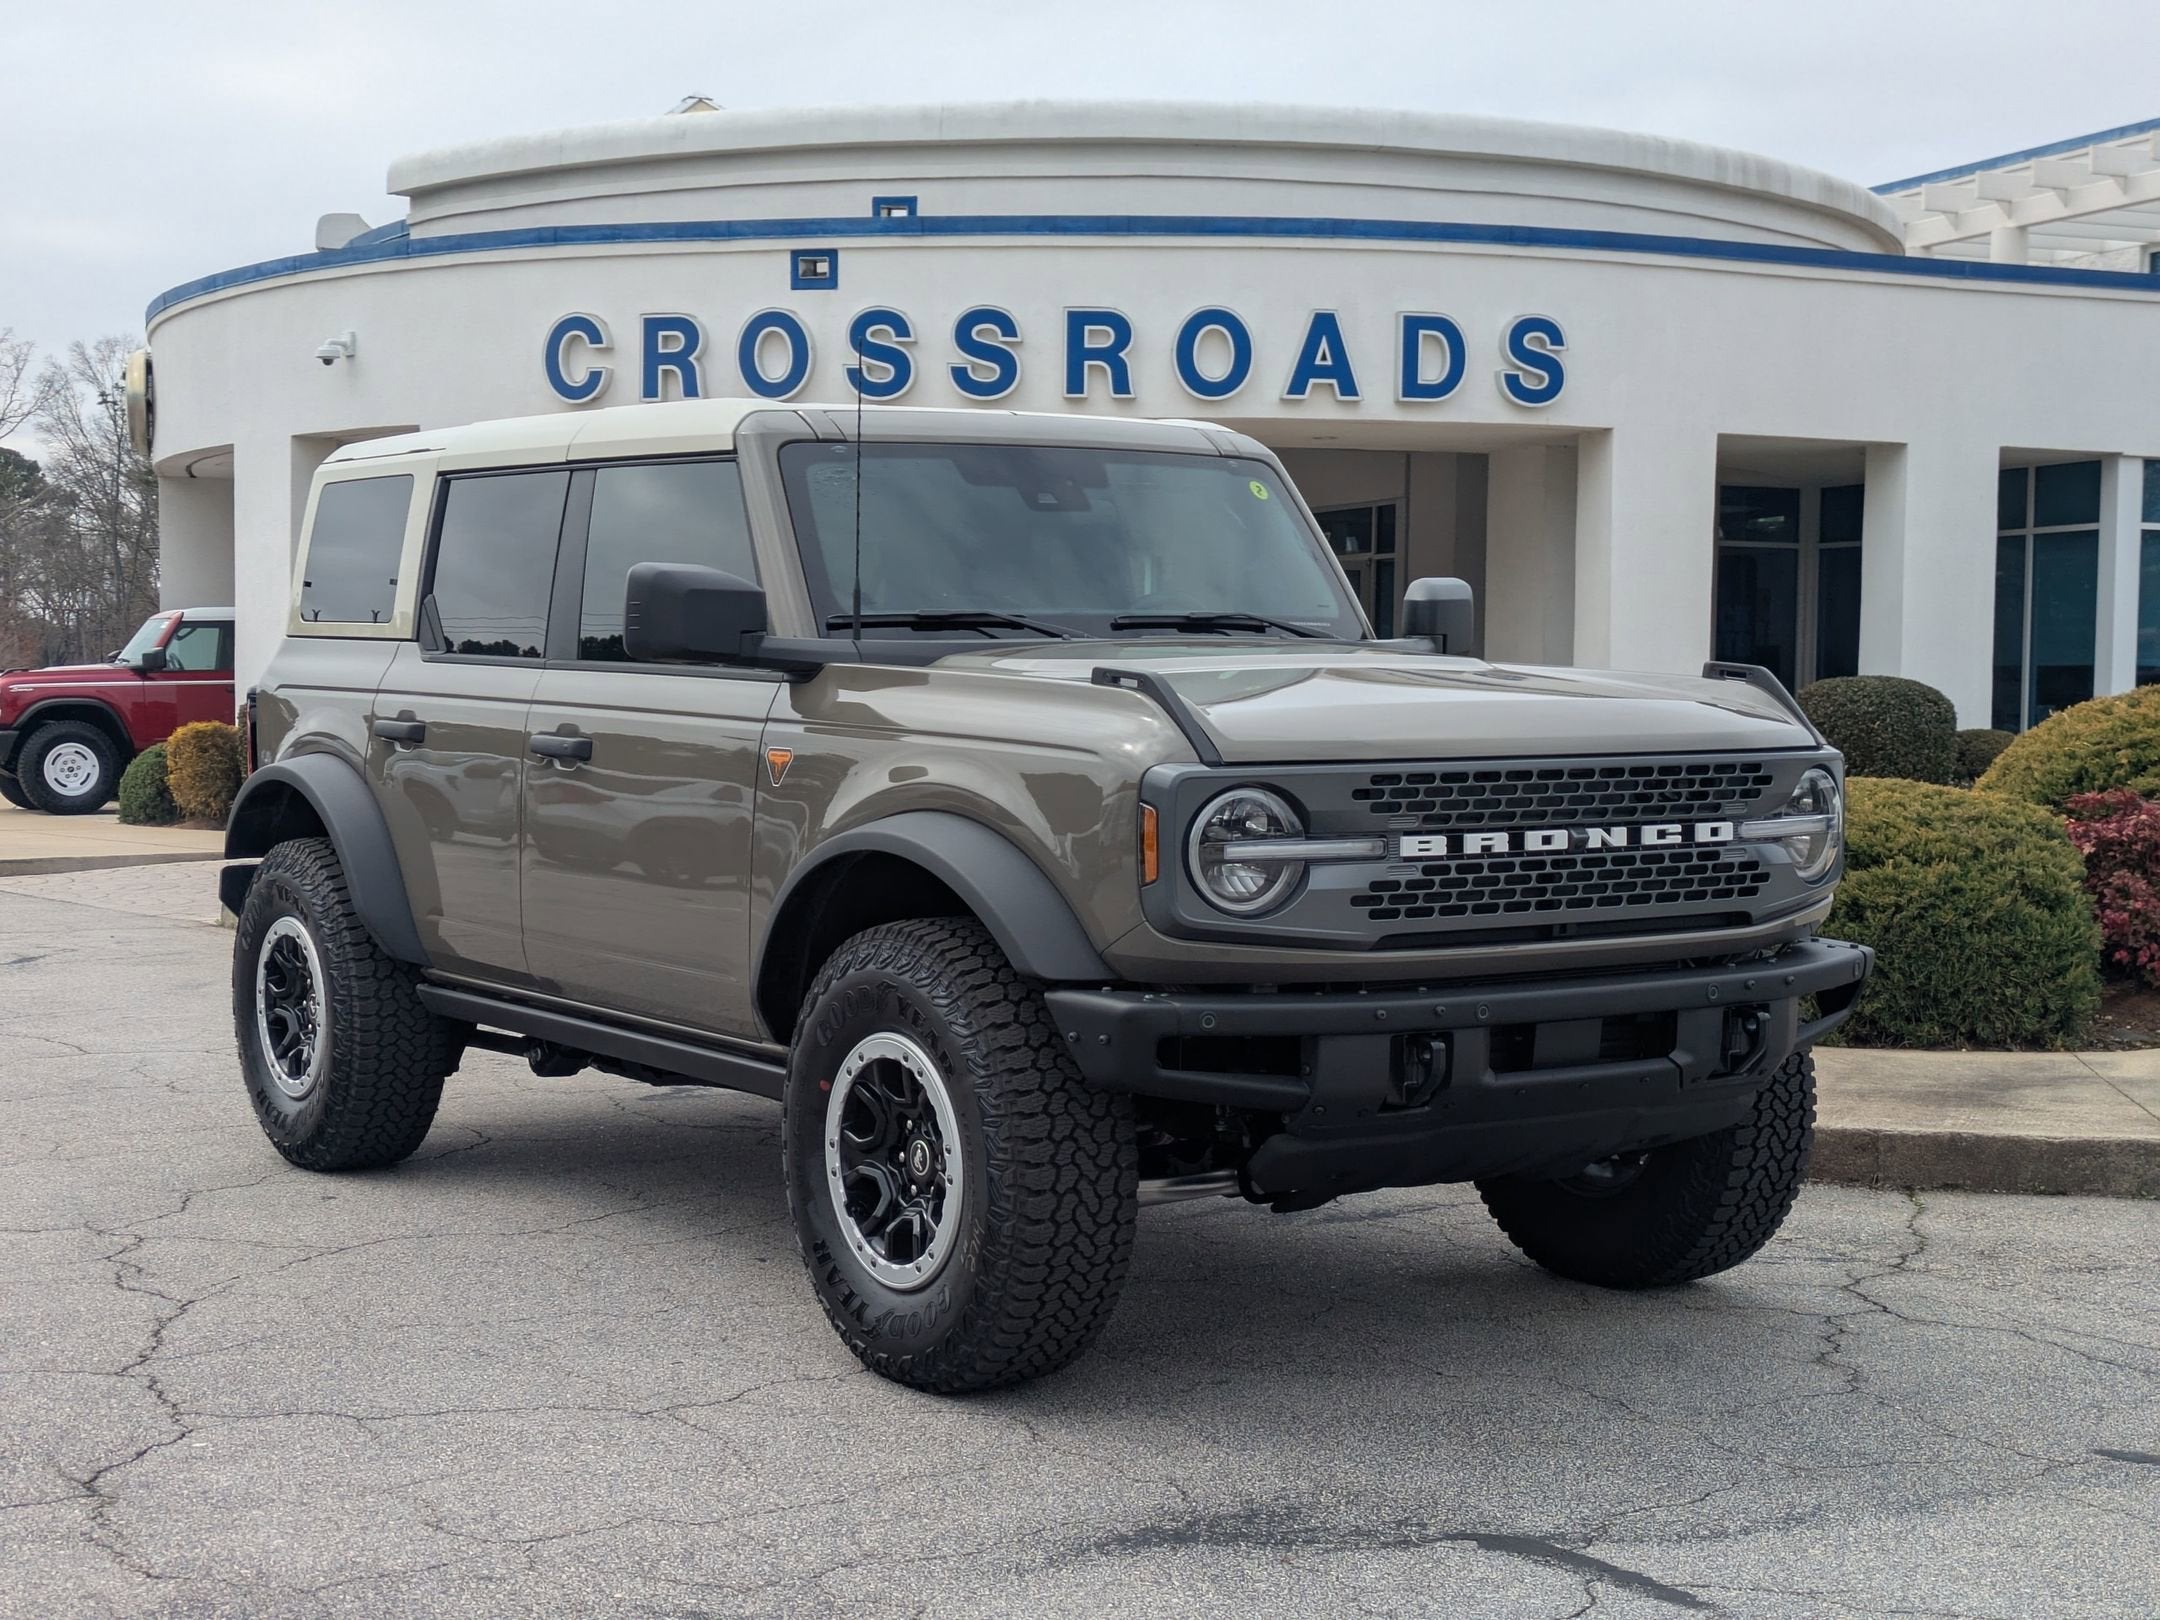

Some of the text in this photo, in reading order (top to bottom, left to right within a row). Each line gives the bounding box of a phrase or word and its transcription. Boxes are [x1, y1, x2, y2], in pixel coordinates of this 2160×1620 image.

[543, 304, 1569, 408] CROSSROADS
[1399, 821, 1734, 857] BRONCO
[816, 980, 953, 1078] GOODYEAR
[812, 1239, 952, 1339] GOODYEAR
